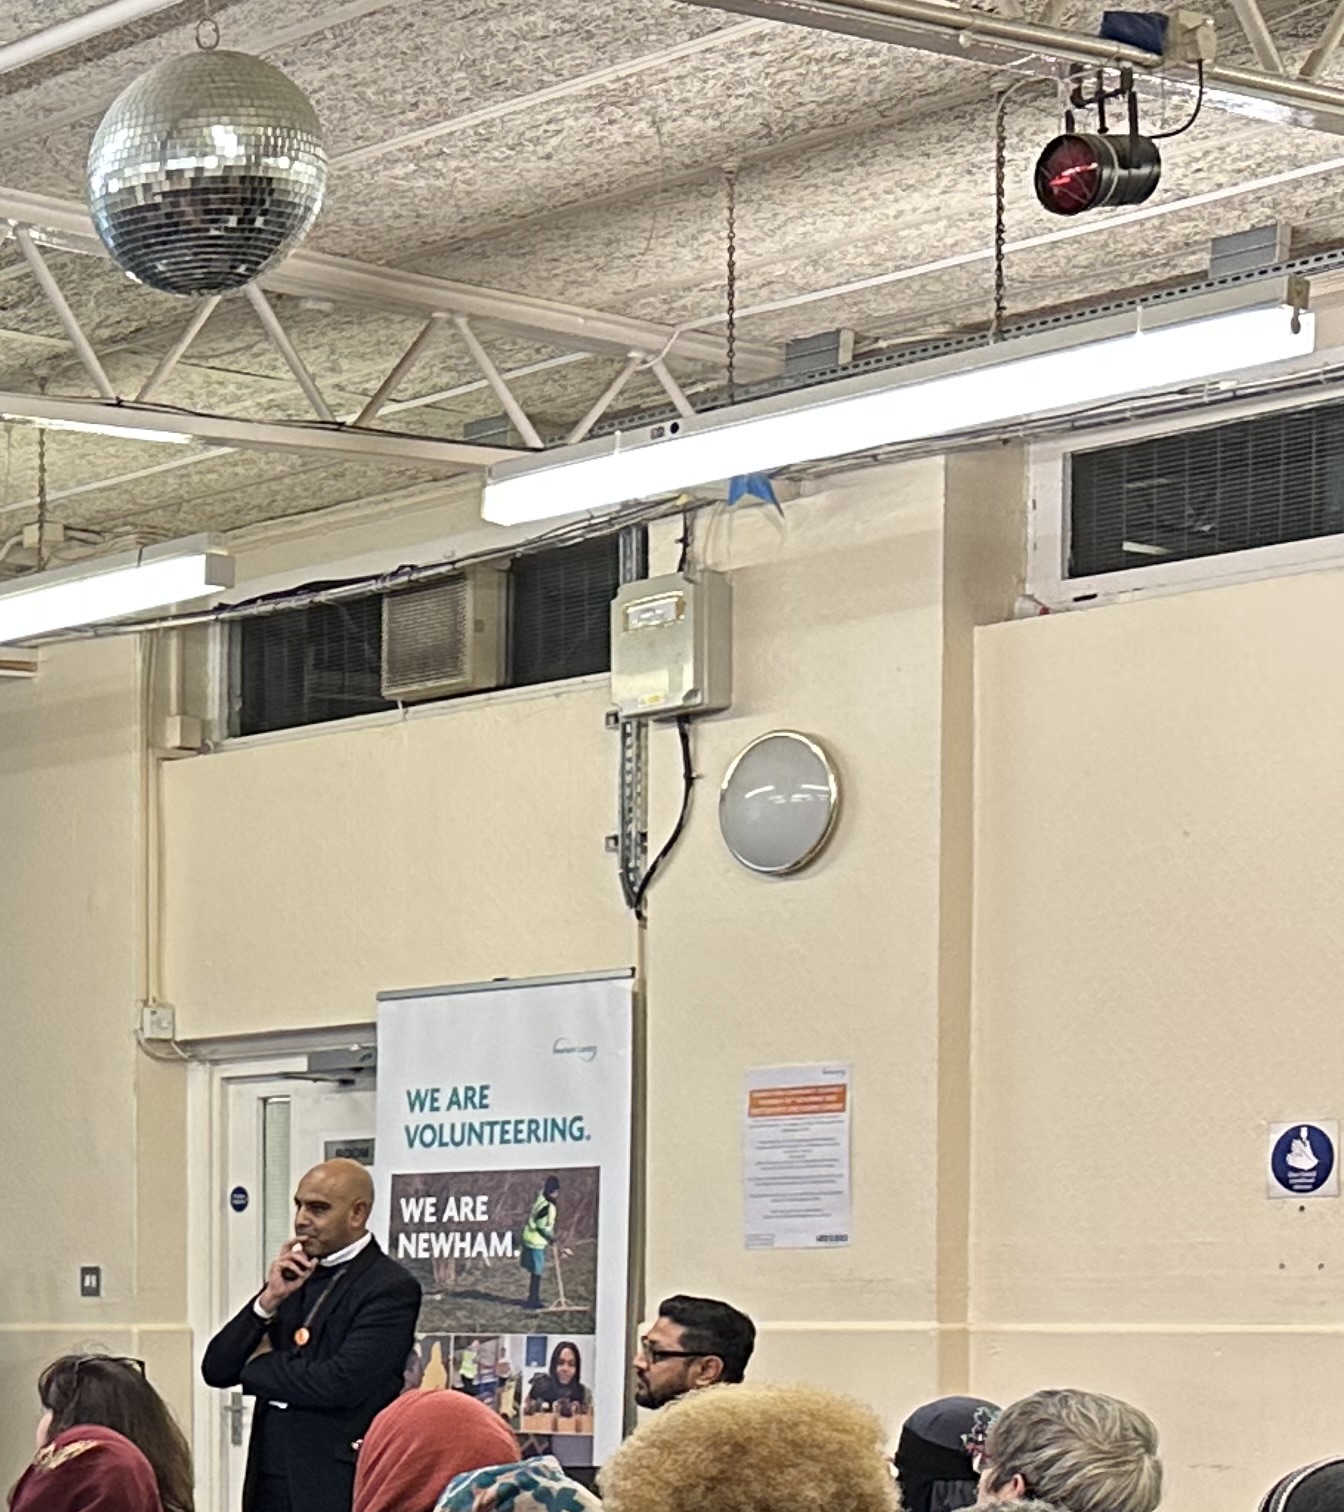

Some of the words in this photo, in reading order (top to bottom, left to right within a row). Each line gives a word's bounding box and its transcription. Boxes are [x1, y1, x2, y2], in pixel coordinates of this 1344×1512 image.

[406, 1086, 440, 1113] WE
[446, 1084, 491, 1112] ARE
[404, 1115, 592, 1150] VOLUNTEERING.
[400, 1197, 438, 1224] WE
[442, 1194, 489, 1223] ARE
[397, 1230, 520, 1260] NEWHAM.
